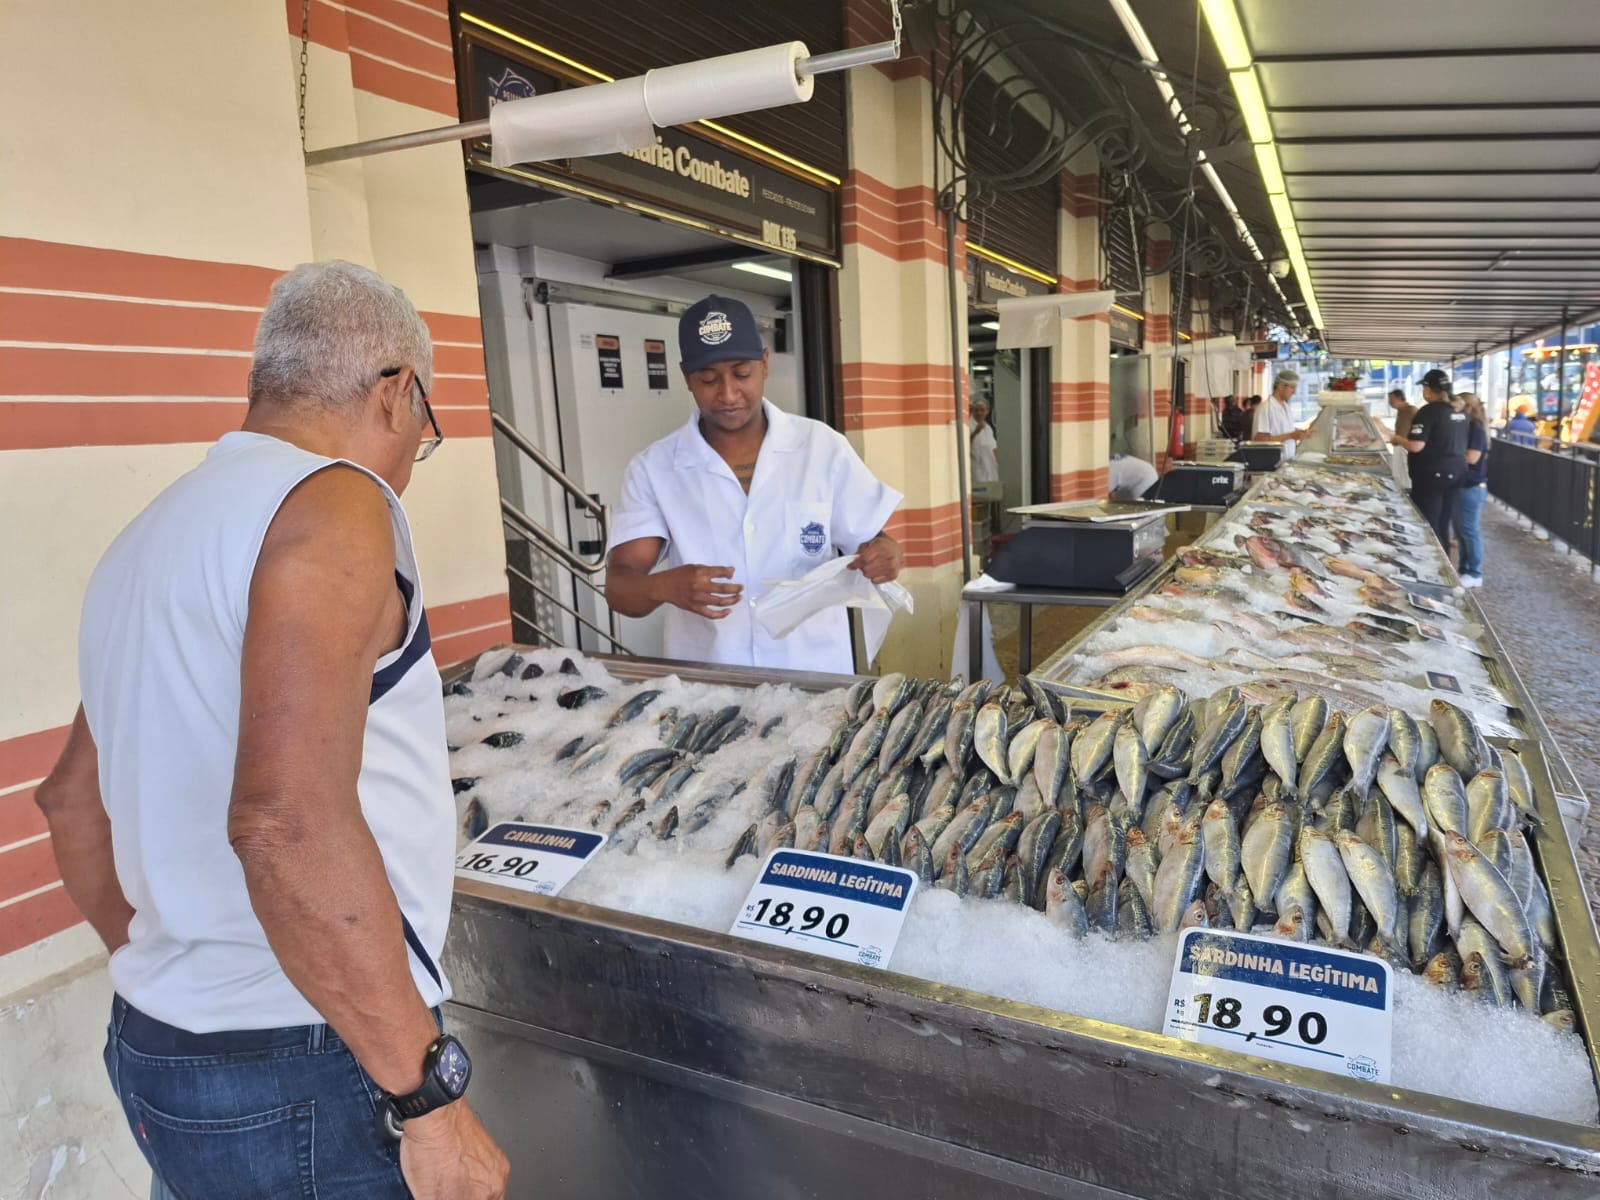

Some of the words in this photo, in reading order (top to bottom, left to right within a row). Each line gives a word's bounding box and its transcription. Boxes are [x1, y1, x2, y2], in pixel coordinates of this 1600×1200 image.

[675, 146, 750, 198] Combate
[699, 322, 732, 335] COMBATE
[800, 534, 825, 544] COMBATE
[503, 830, 577, 850] CAVALINHA
[463, 853, 539, 877] 16,90
[770, 862, 837, 885] SARDINHA
[838, 873, 903, 898] LEGÍTIMA
[754, 898, 850, 939] 18,90
[1189, 945, 1284, 975] SARDINHA
[1288, 961, 1379, 994] LEGÍTIMA
[1174, 998, 1185, 1008] R$
[1193, 993, 1328, 1045] 18,90
[1346, 1062, 1380, 1076] COMBATE
